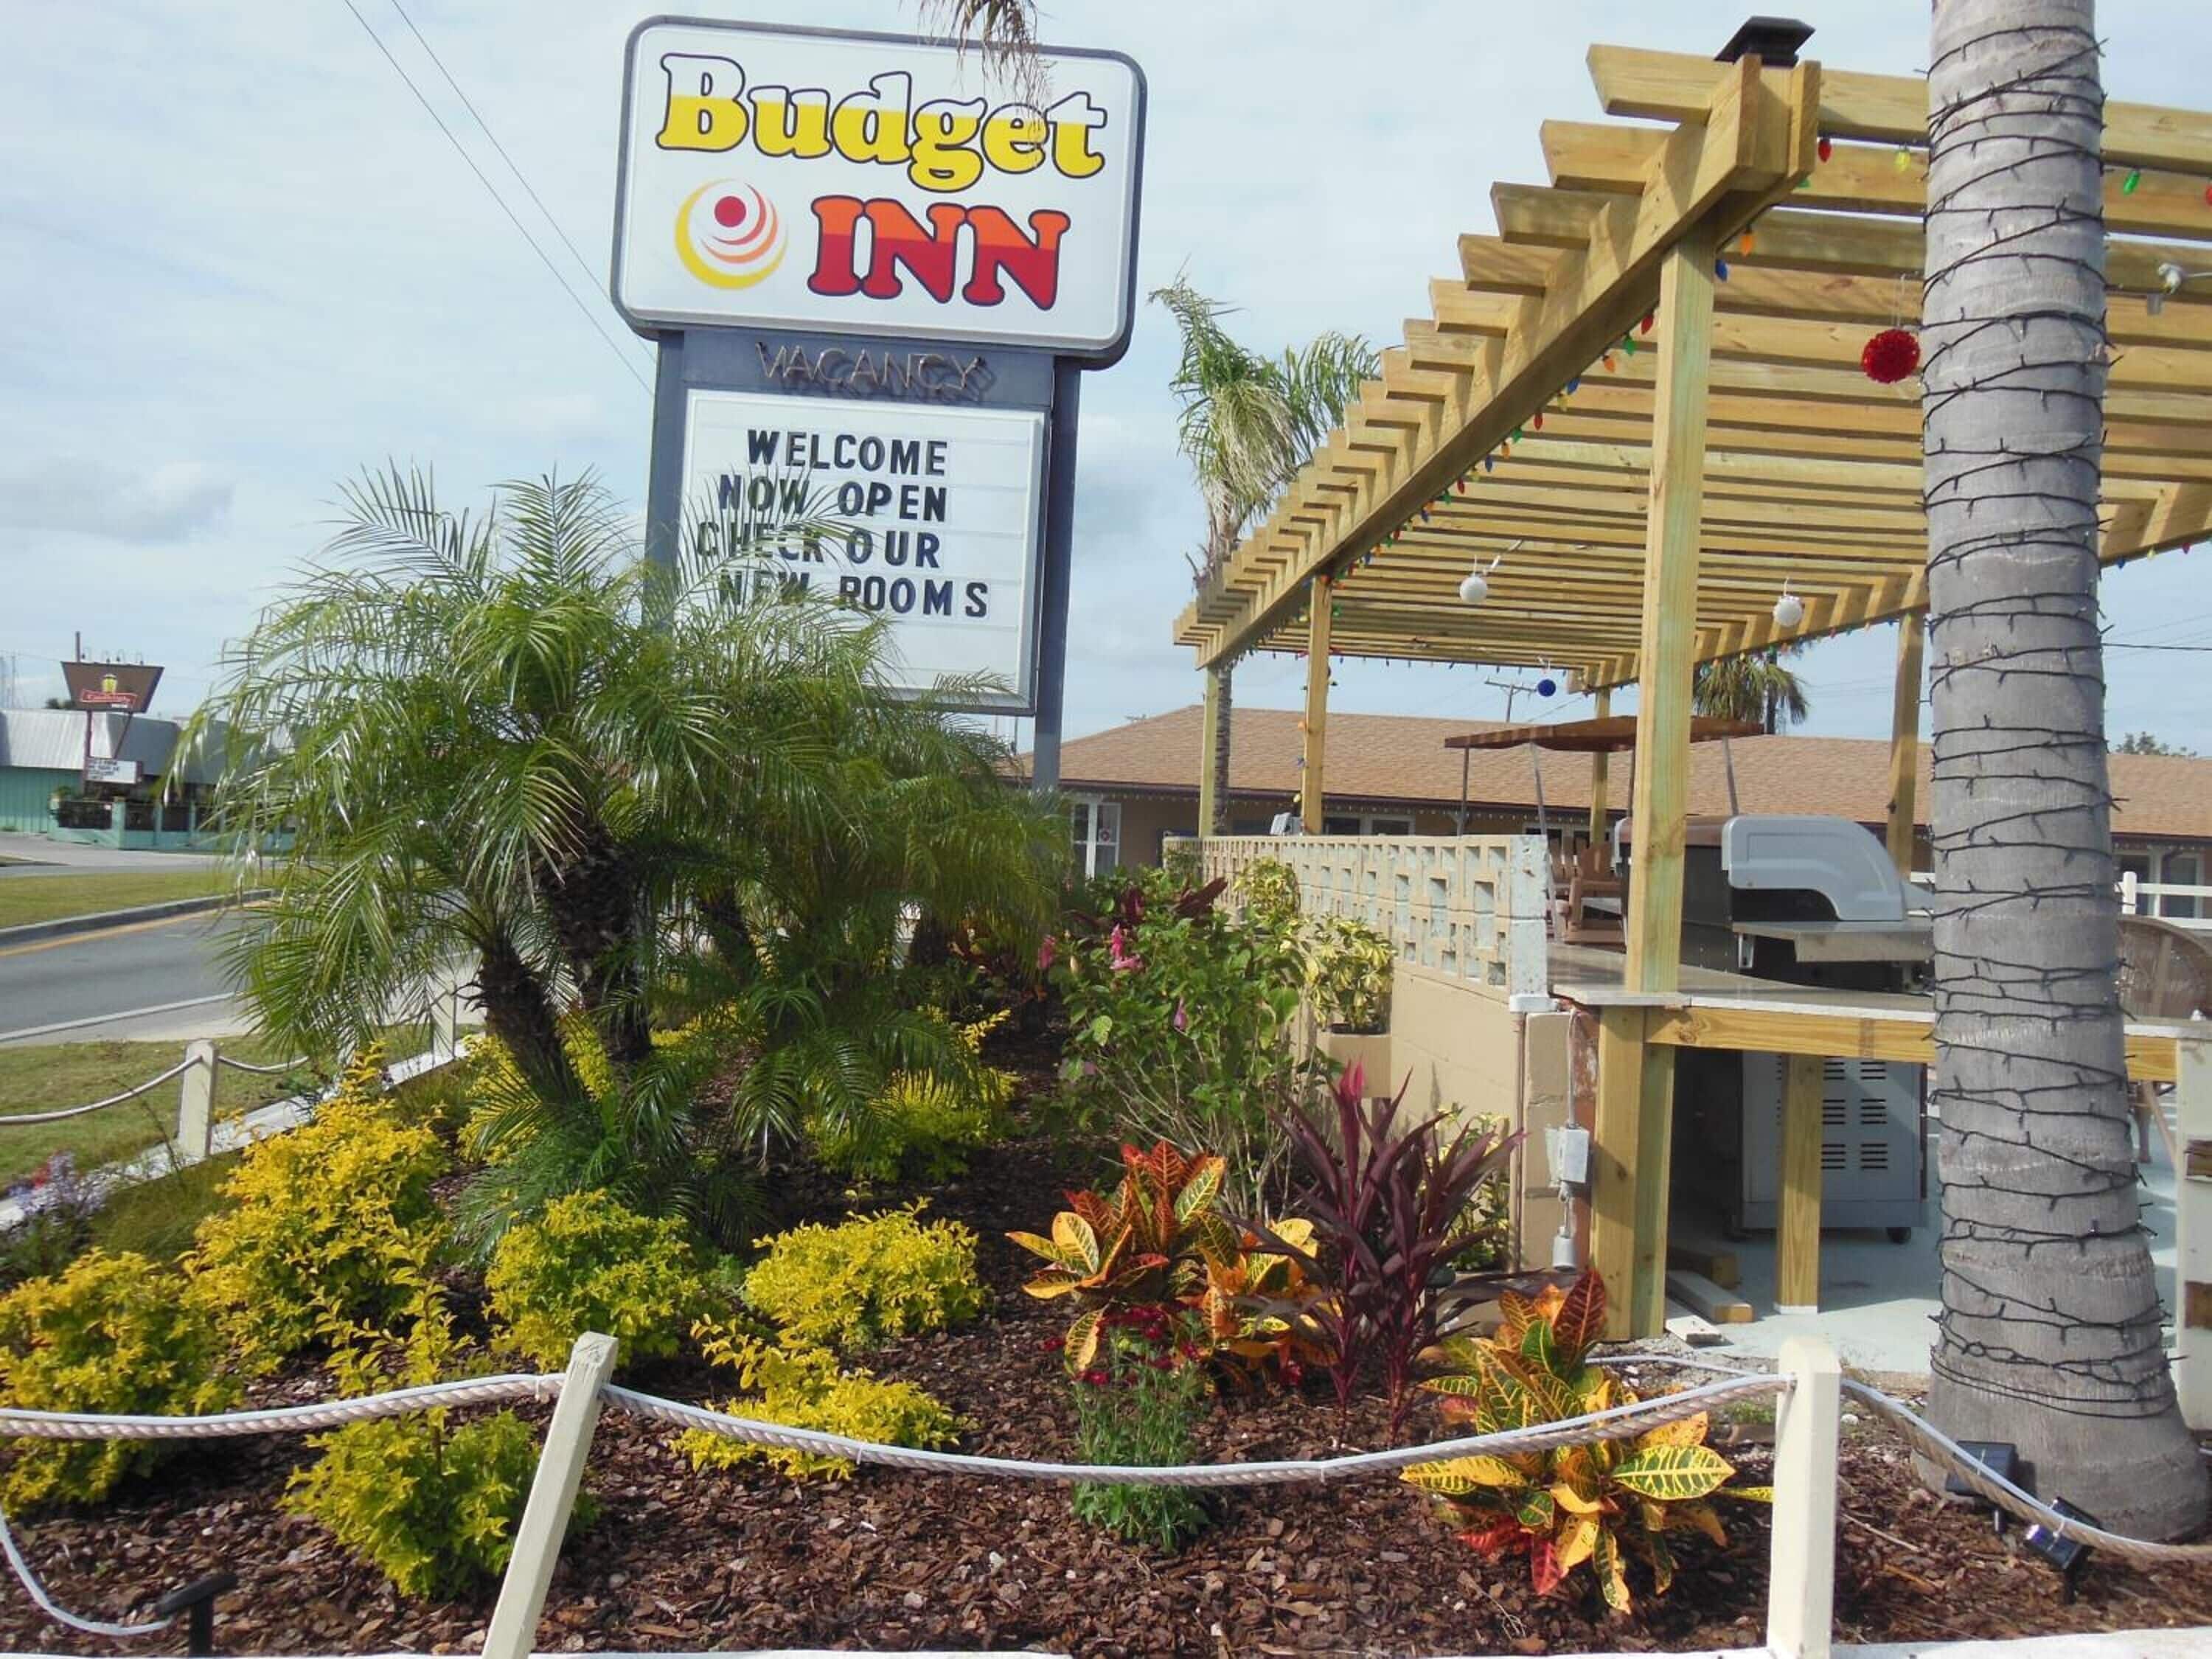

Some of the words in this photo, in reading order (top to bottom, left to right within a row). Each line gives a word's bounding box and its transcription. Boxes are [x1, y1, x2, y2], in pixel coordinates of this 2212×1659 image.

[655, 53, 1107, 192] Budget
[807, 195, 1071, 310] INN
[755, 341, 987, 390] VACANCY
[747, 429, 947, 476] WELCOME
[719, 474, 810, 514] NOW
[838, 481, 947, 522] OPEN
[846, 529, 940, 568] OUR
[838, 575, 988, 618] ROOMS
